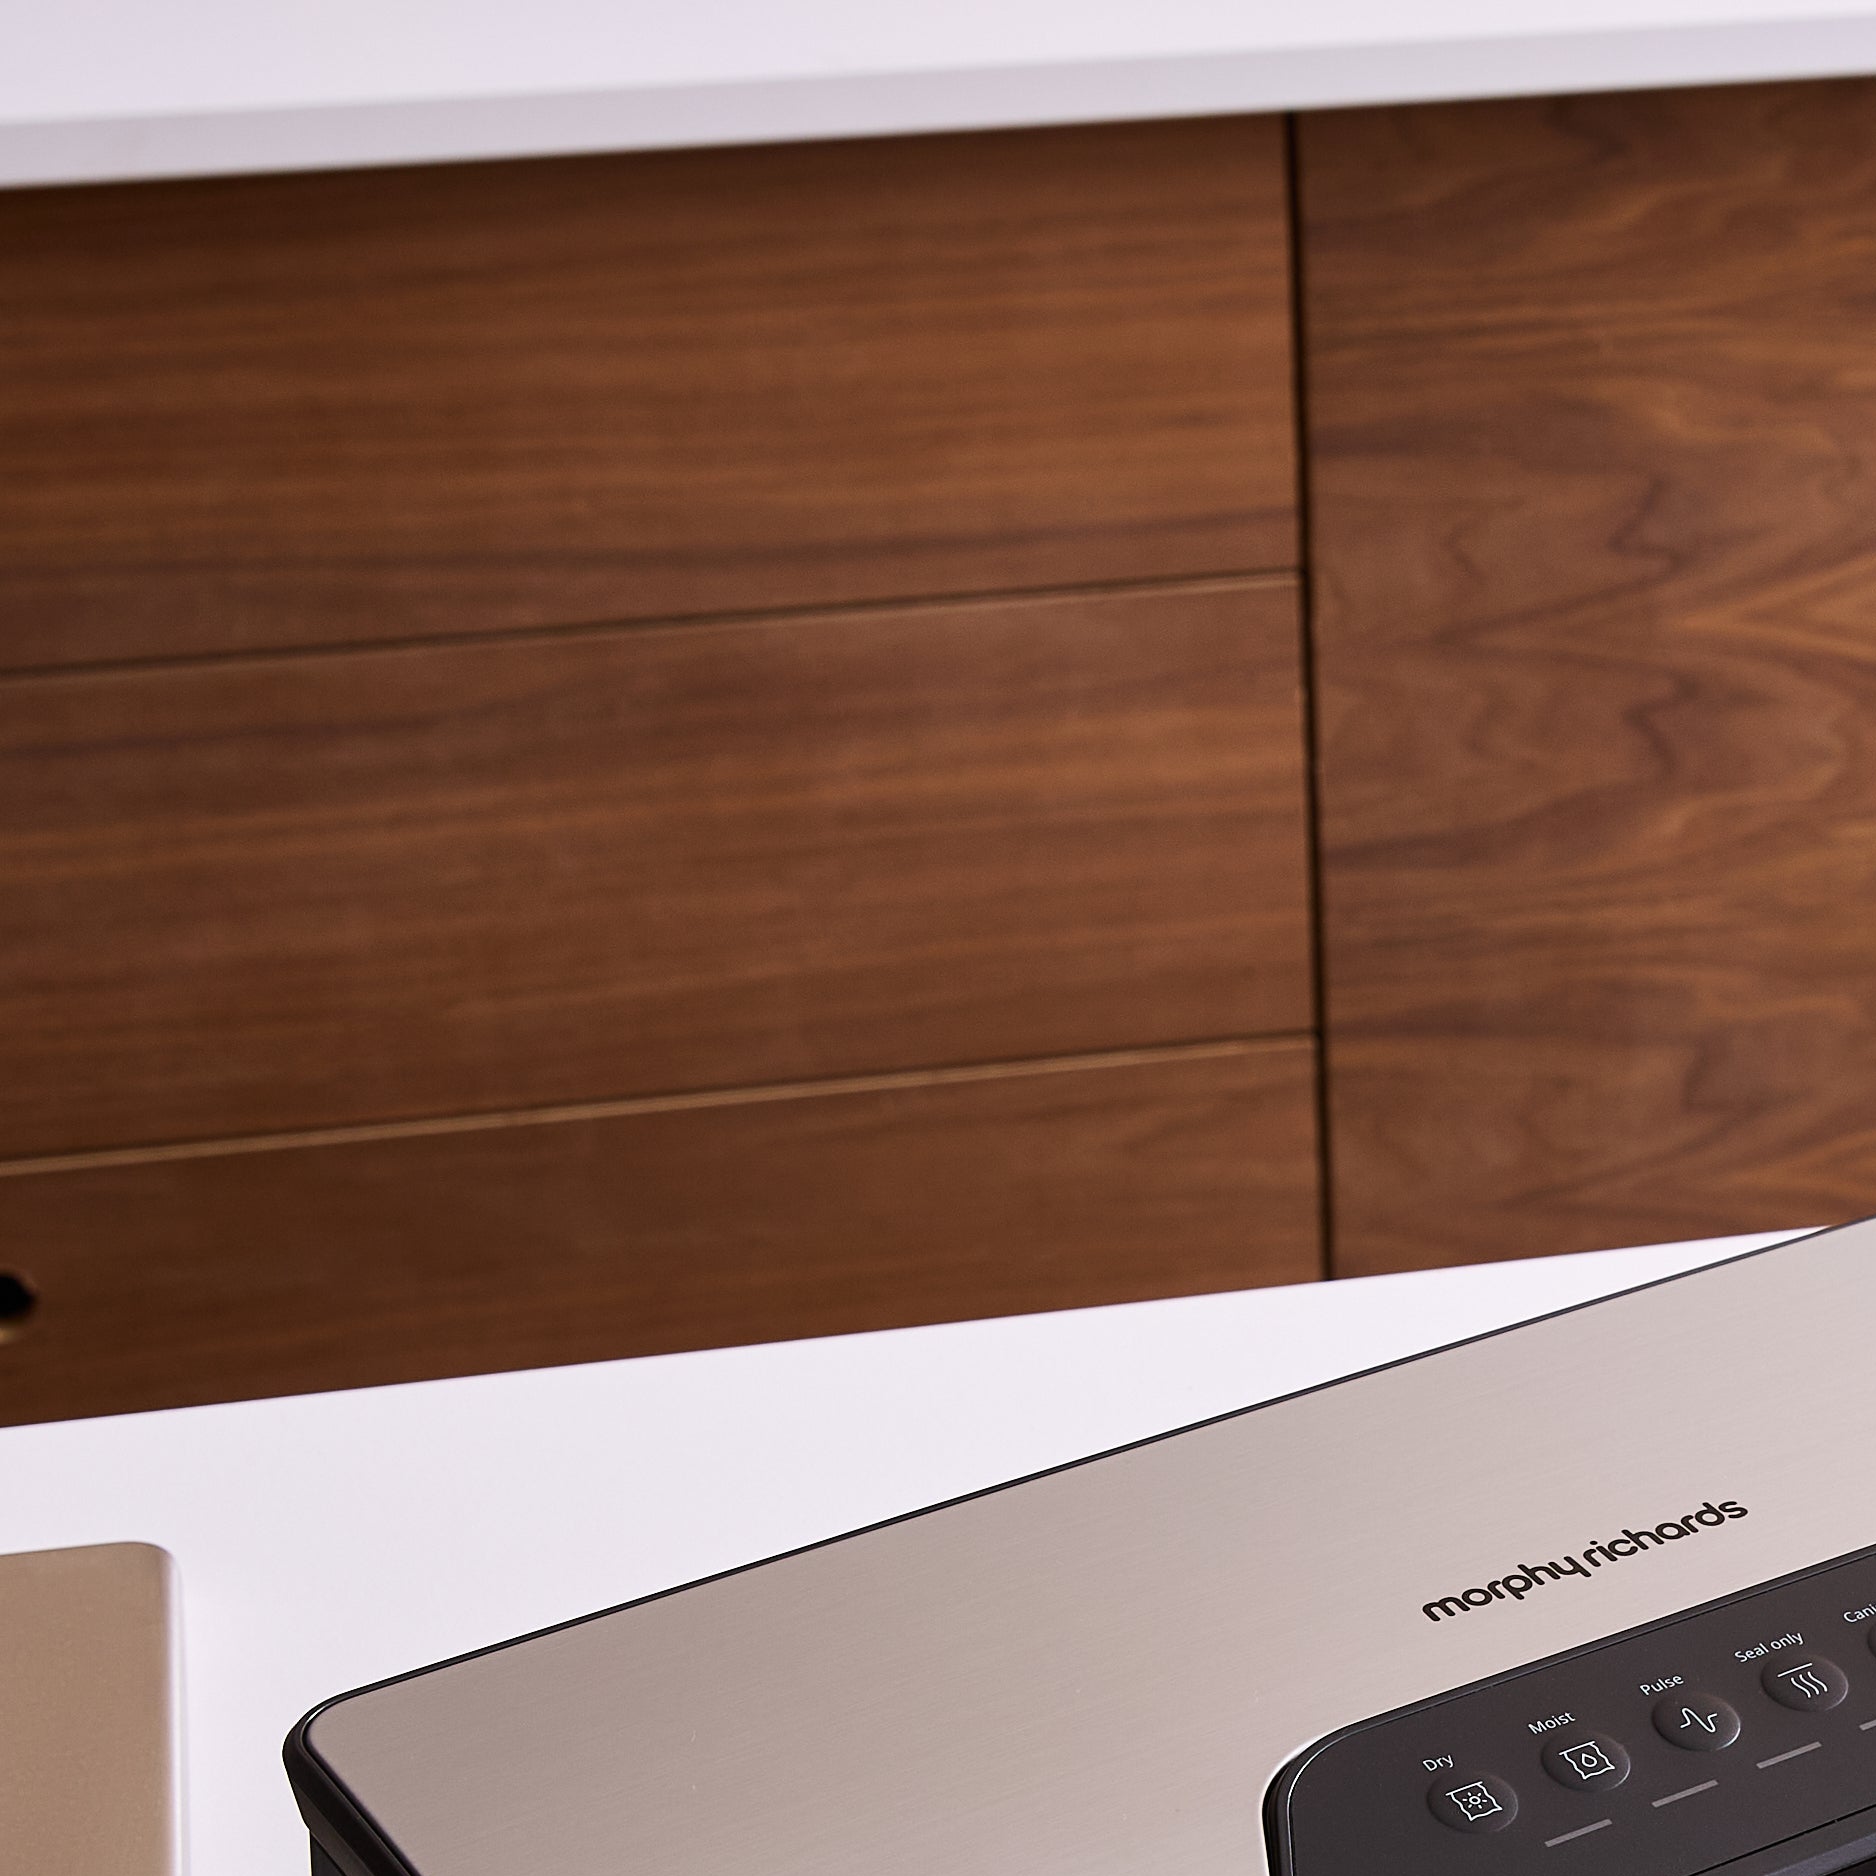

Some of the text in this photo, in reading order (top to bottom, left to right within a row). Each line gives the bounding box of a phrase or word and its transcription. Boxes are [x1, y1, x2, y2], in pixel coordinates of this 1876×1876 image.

[1422, 1501, 1749, 1622] morphy richards
[1734, 1631, 1805, 1663] Seal only
[1639, 1673, 1684, 1696] Pulse
[1528, 1711, 1576, 1735] Moist
[1422, 1754, 1454, 1772] Dry
